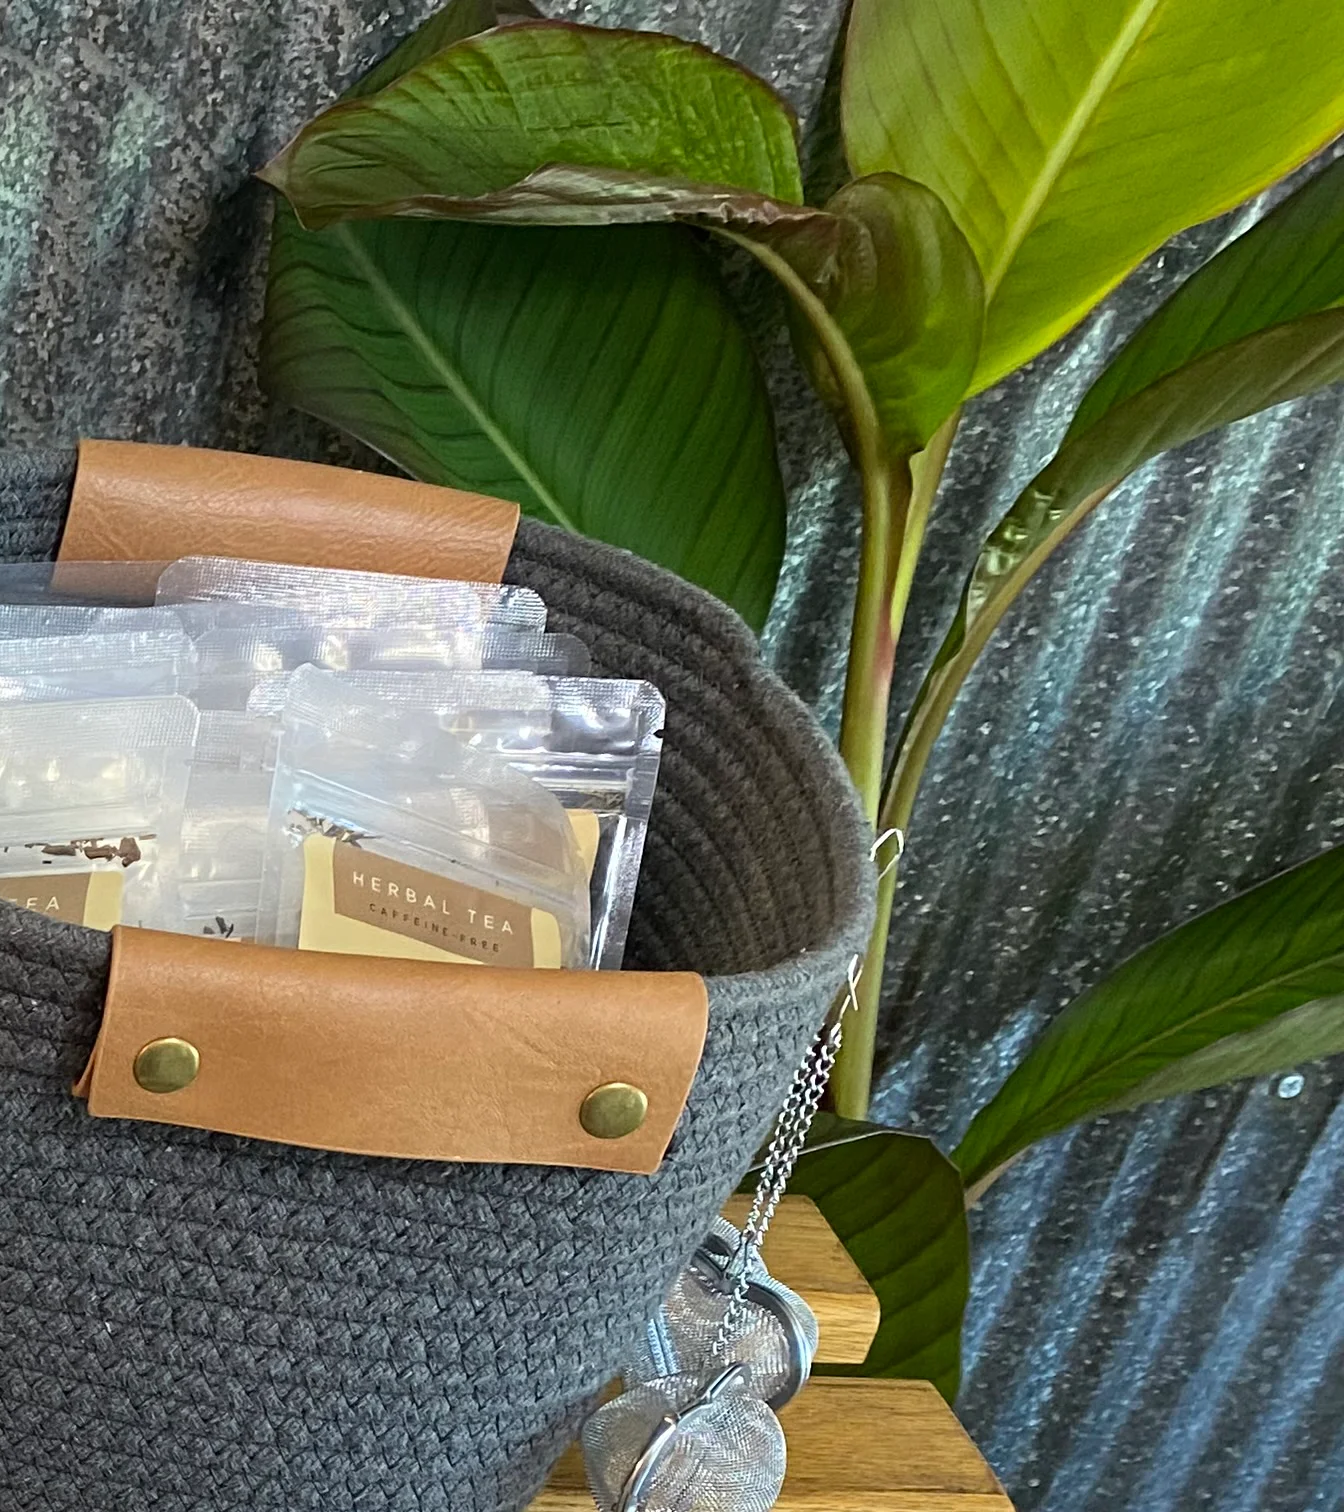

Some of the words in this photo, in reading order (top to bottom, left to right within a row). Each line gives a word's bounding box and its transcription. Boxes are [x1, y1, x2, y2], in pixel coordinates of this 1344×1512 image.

[353, 871, 450, 915] HERBAL
[467, 909, 514, 935] TEA
[369, 903, 500, 952] CAFFEINE-FREE
